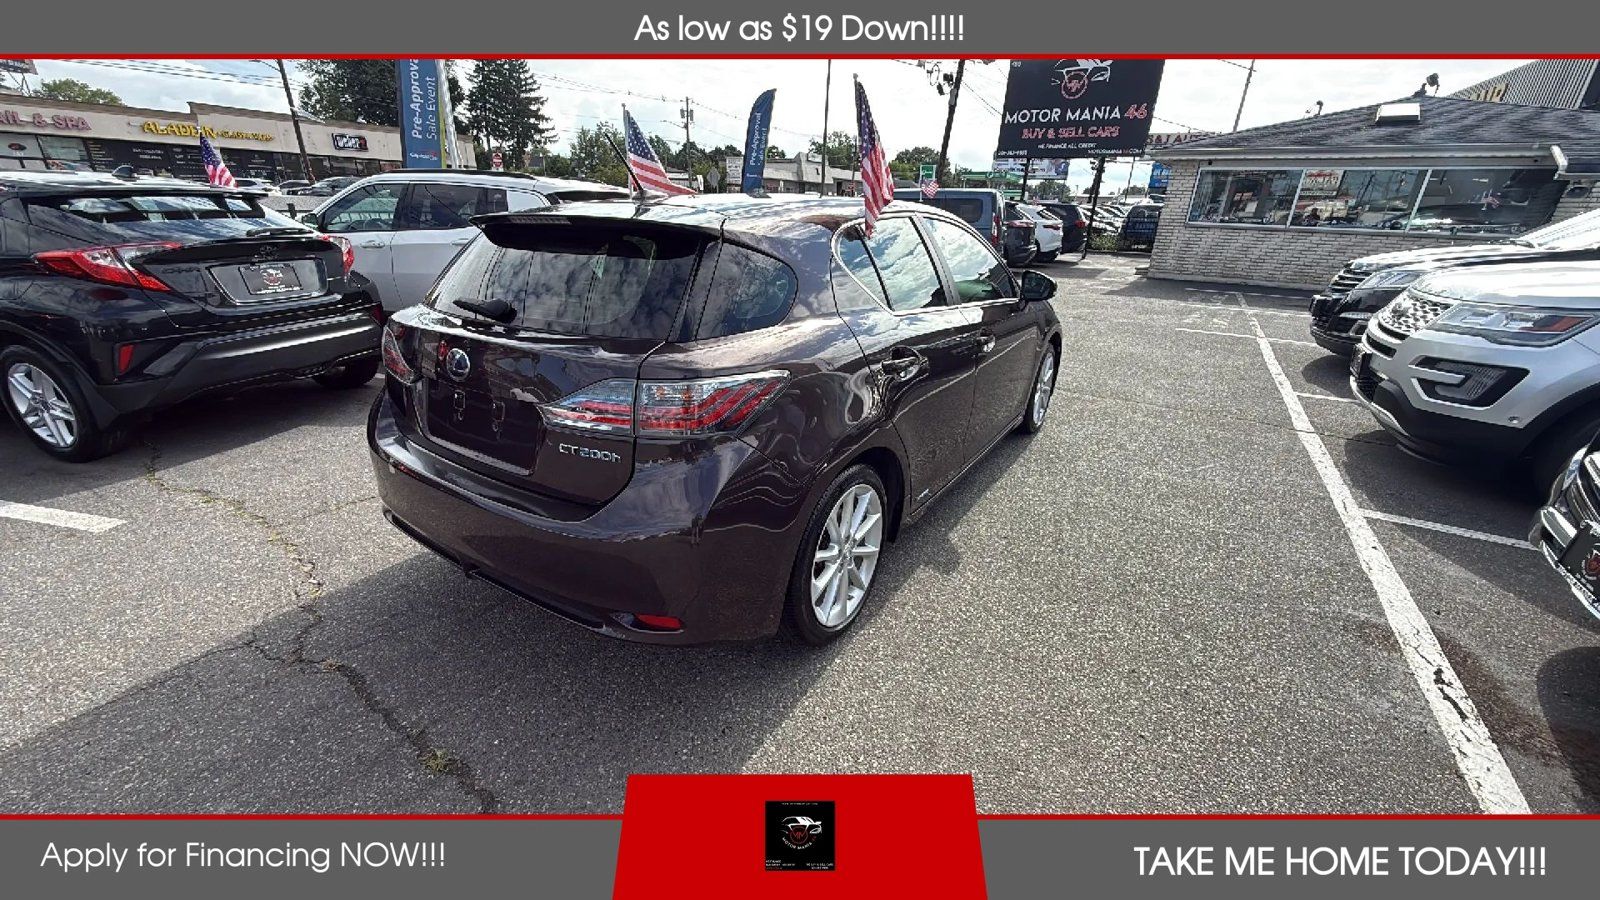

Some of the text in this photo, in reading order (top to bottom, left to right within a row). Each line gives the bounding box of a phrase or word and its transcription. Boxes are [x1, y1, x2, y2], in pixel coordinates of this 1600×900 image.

[425, 76, 437, 141] Sale Event
[1005, 102, 1148, 124] MOTOR MANIA 46
[33, 112, 48, 128] &
[52, 114, 92, 131] SPA
[1021, 125, 1120, 139] BUY & SELL CARS
